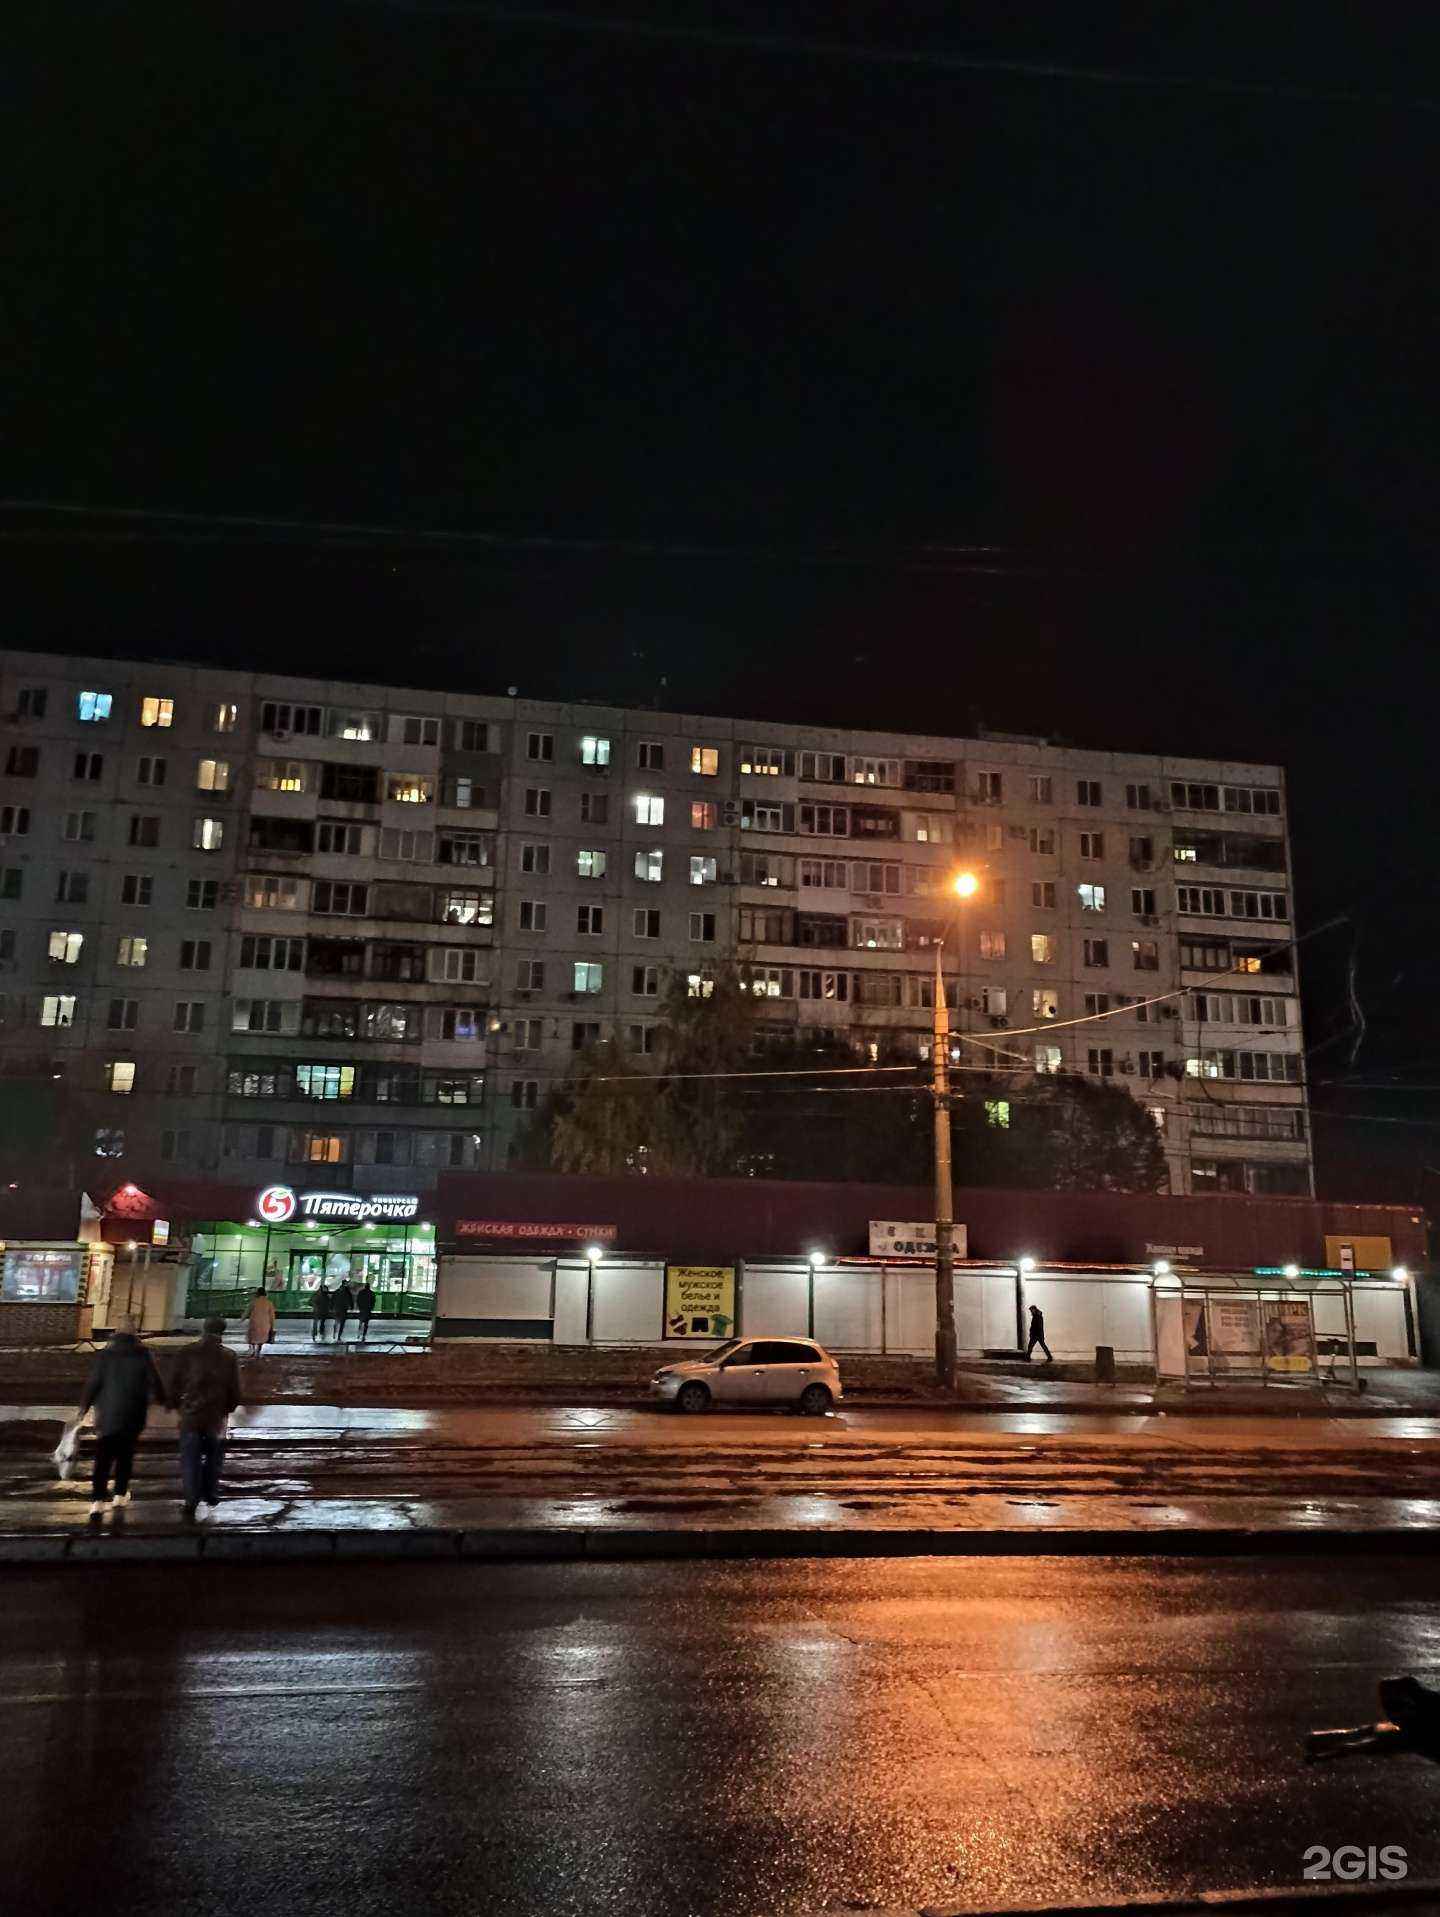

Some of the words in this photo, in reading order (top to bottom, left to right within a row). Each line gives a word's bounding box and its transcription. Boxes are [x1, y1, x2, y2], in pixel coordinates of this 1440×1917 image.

[300, 1194, 418, 1220] Пятерочка
[460, 1223, 514, 1235] ЖЕНСКАЯ
[518, 1225, 564, 1237] ОДЕЖДА
[893, 1241, 960, 1255] ОДЕЖА
[680, 1304, 721, 1314] одежда
